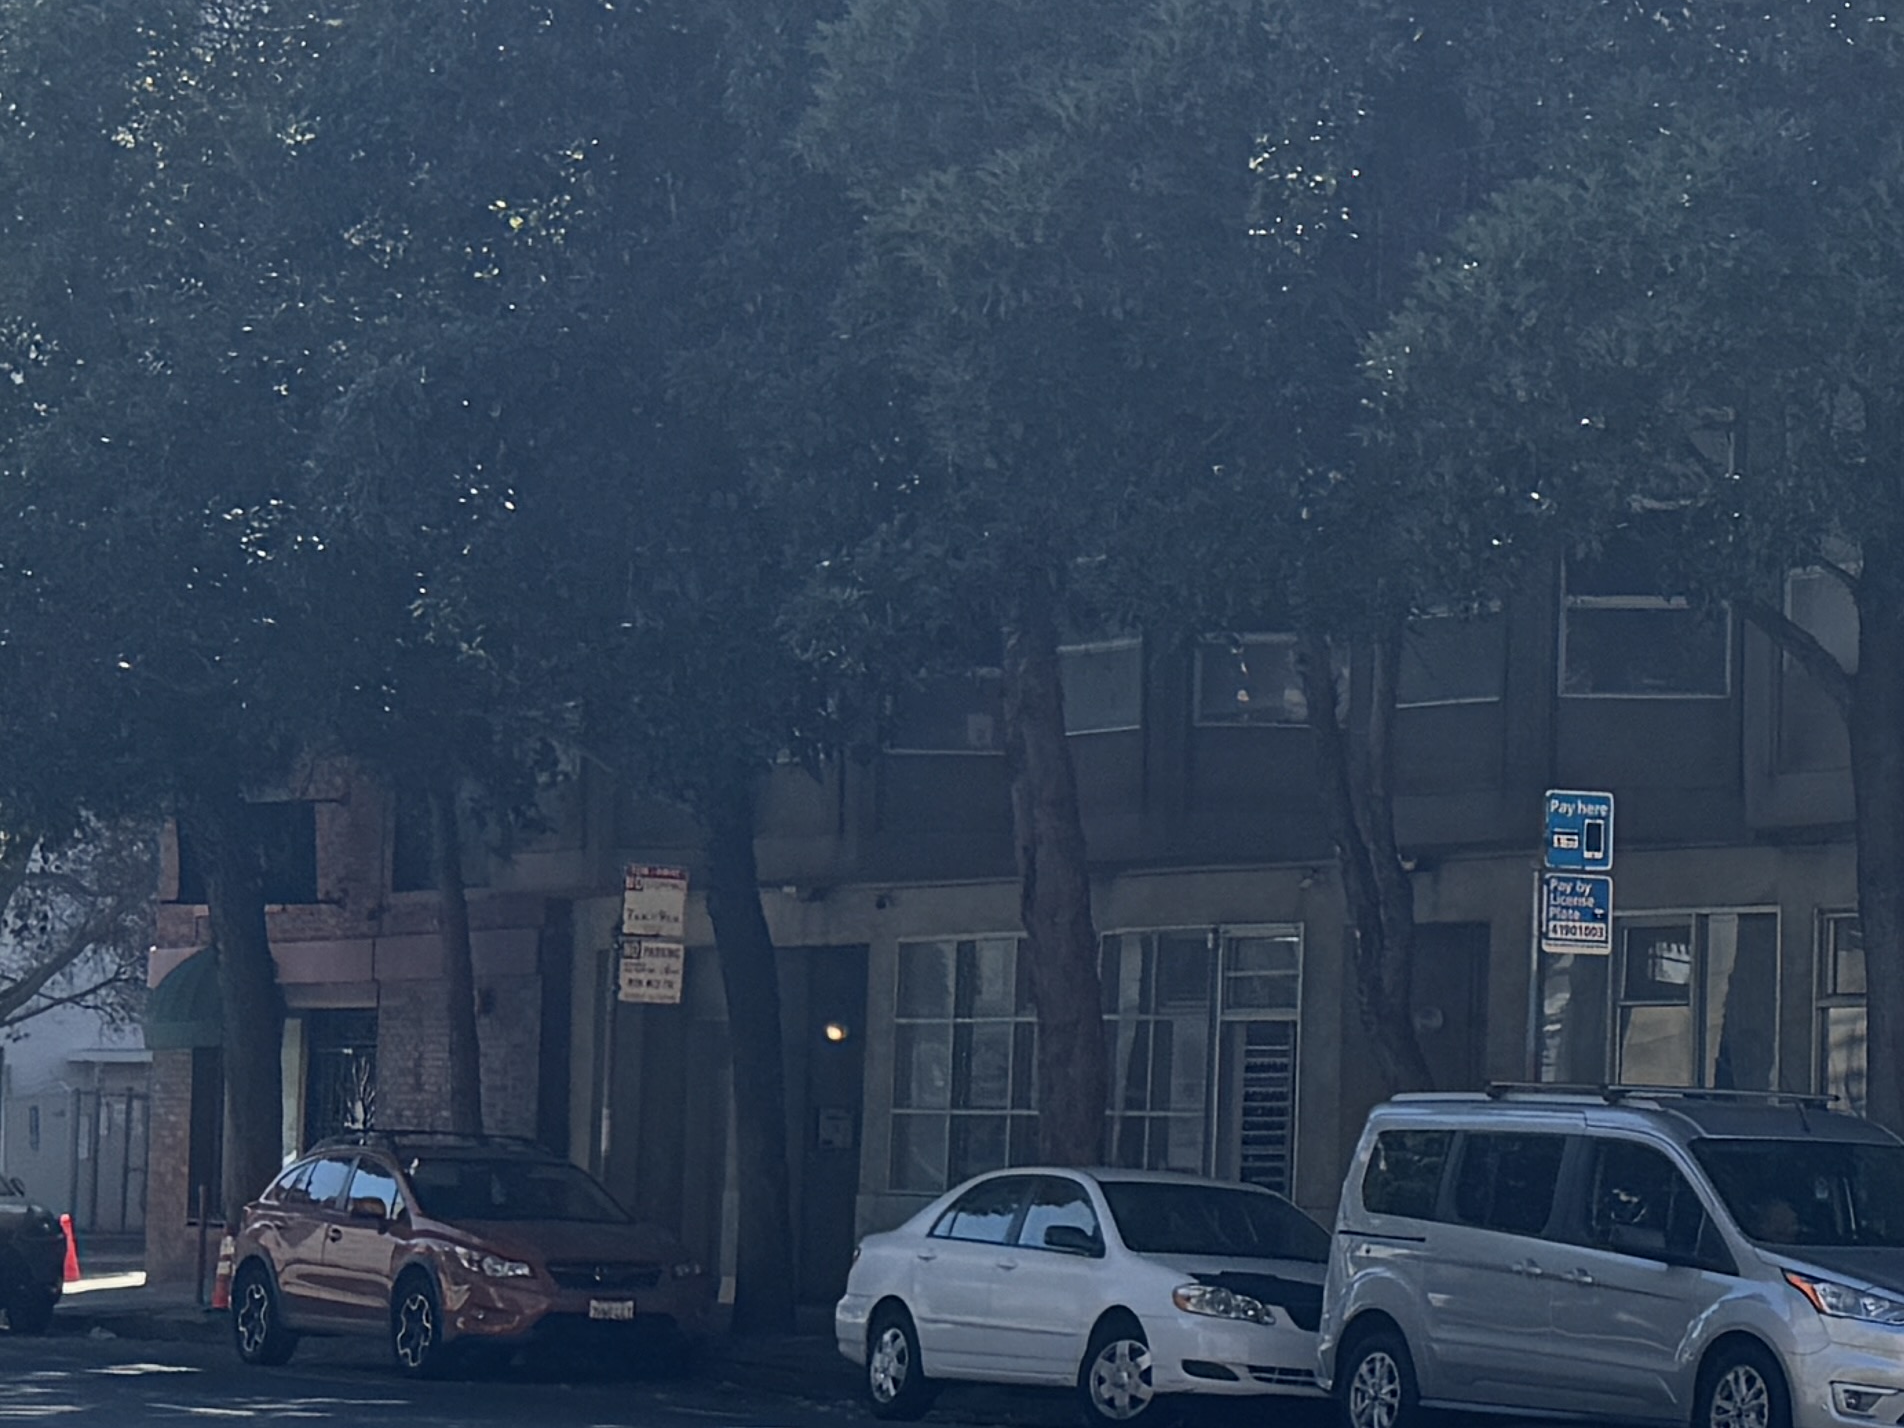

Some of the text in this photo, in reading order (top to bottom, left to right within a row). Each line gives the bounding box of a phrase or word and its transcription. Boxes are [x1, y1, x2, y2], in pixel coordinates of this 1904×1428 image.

[1550, 798, 1609, 817] Pay here
[1550, 878, 1593, 896] Pay by
[1549, 892, 1595, 908] License
[1549, 906, 1581, 921] Plate
